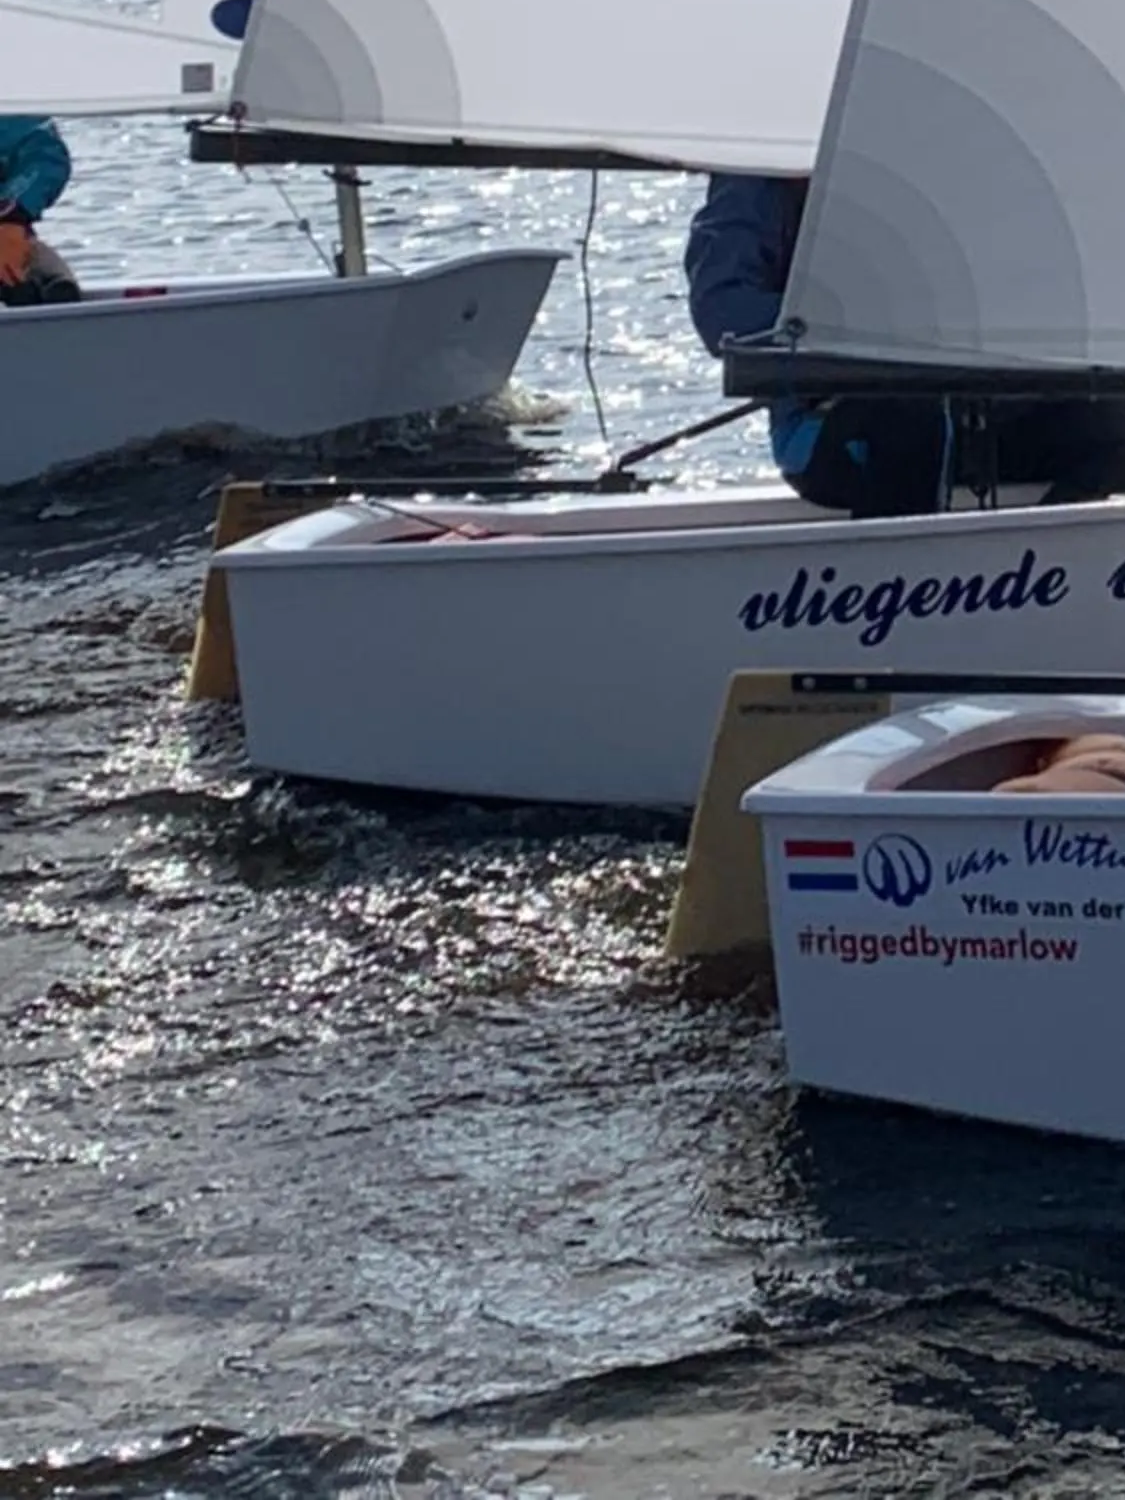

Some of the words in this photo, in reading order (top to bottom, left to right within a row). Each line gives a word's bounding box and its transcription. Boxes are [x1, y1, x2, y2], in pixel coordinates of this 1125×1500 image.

[738, 549, 1070, 647] vliegende
[945, 846, 1010, 885] van
[961, 892, 1020, 915] Yfke
[1027, 899, 1074, 917] van
[1081, 897, 1125, 920] der
[797, 924, 1078, 967] #riggedbymarlow
